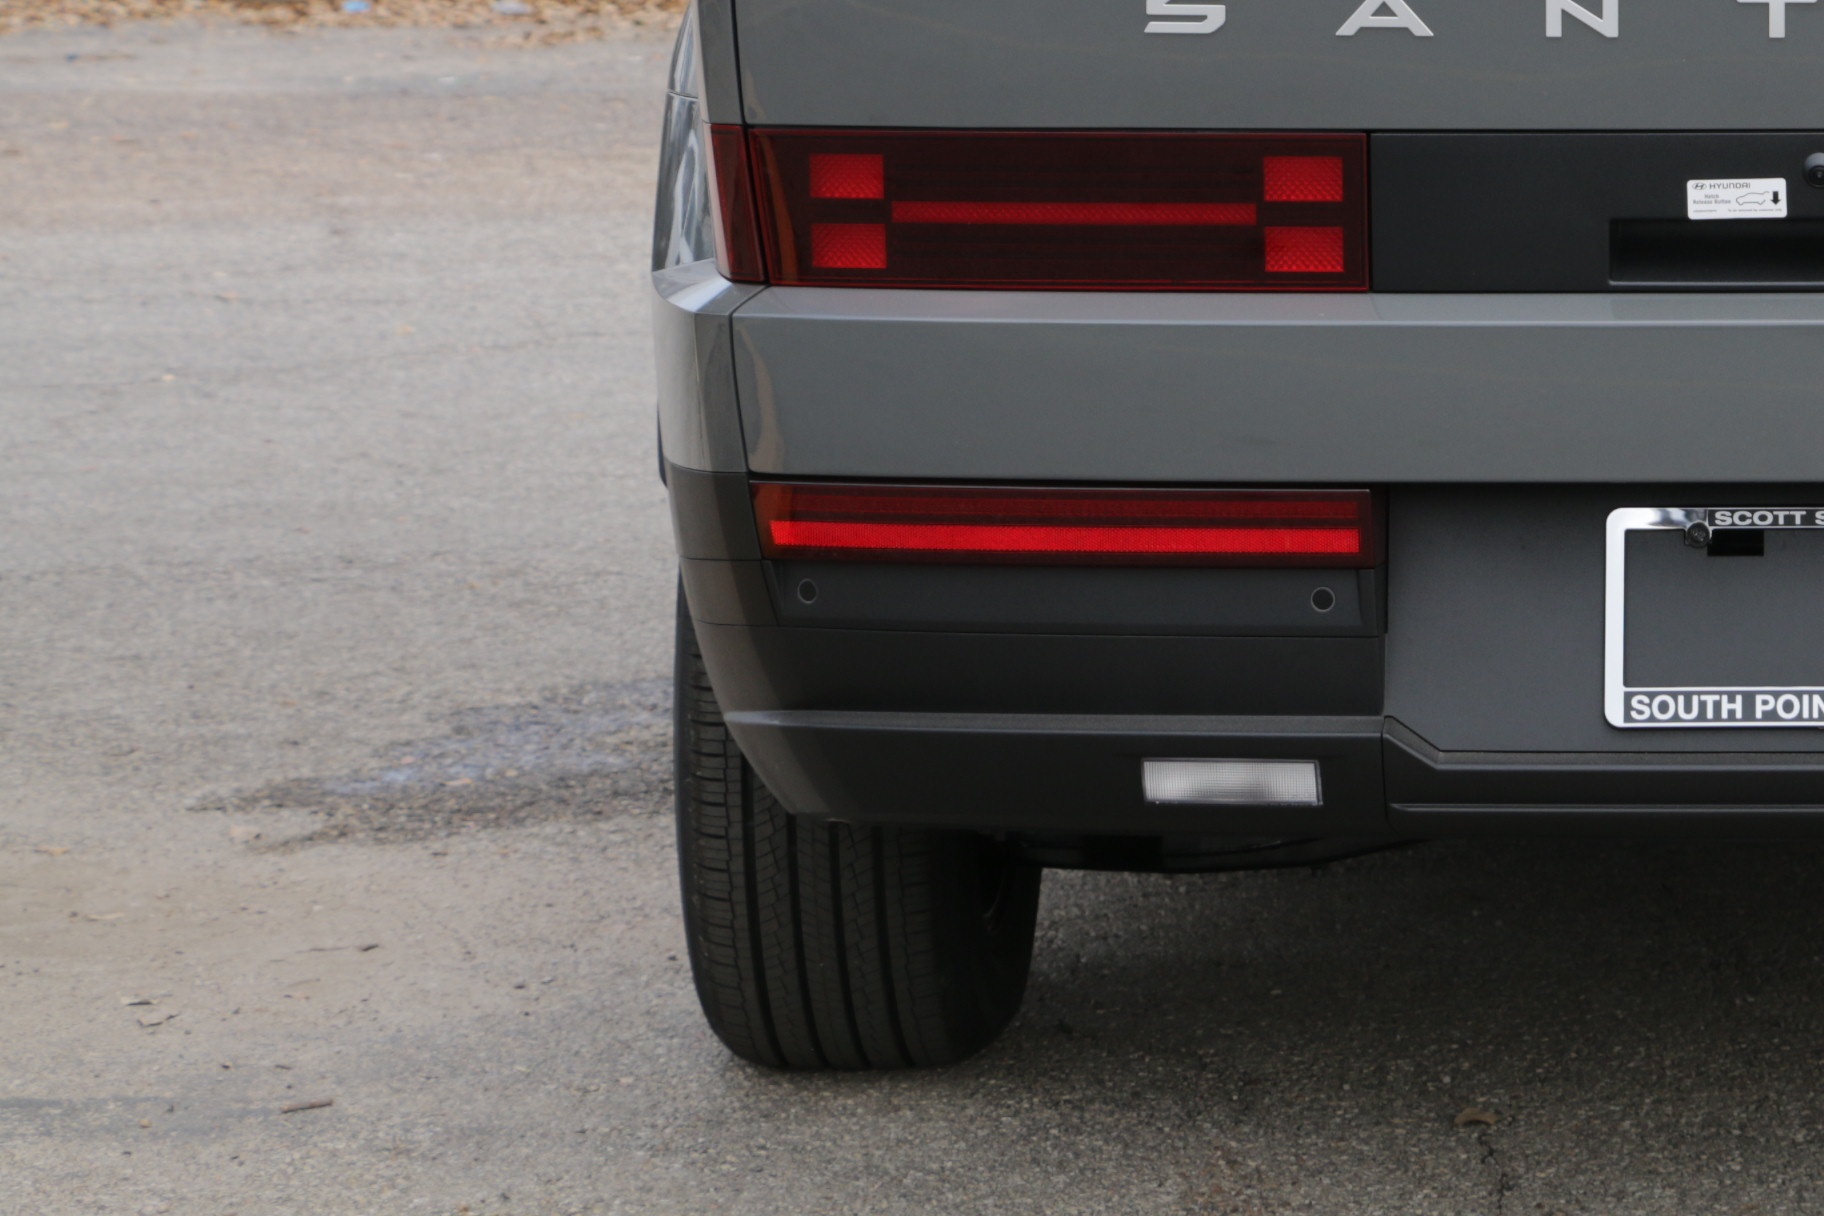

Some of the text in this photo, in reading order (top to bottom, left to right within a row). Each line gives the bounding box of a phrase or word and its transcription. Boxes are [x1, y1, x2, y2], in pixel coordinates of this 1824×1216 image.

[1709, 182, 1751, 190] HYUNDAI
[1714, 510, 1807, 526] SCOTT
[1630, 694, 1743, 721] SOUTH
